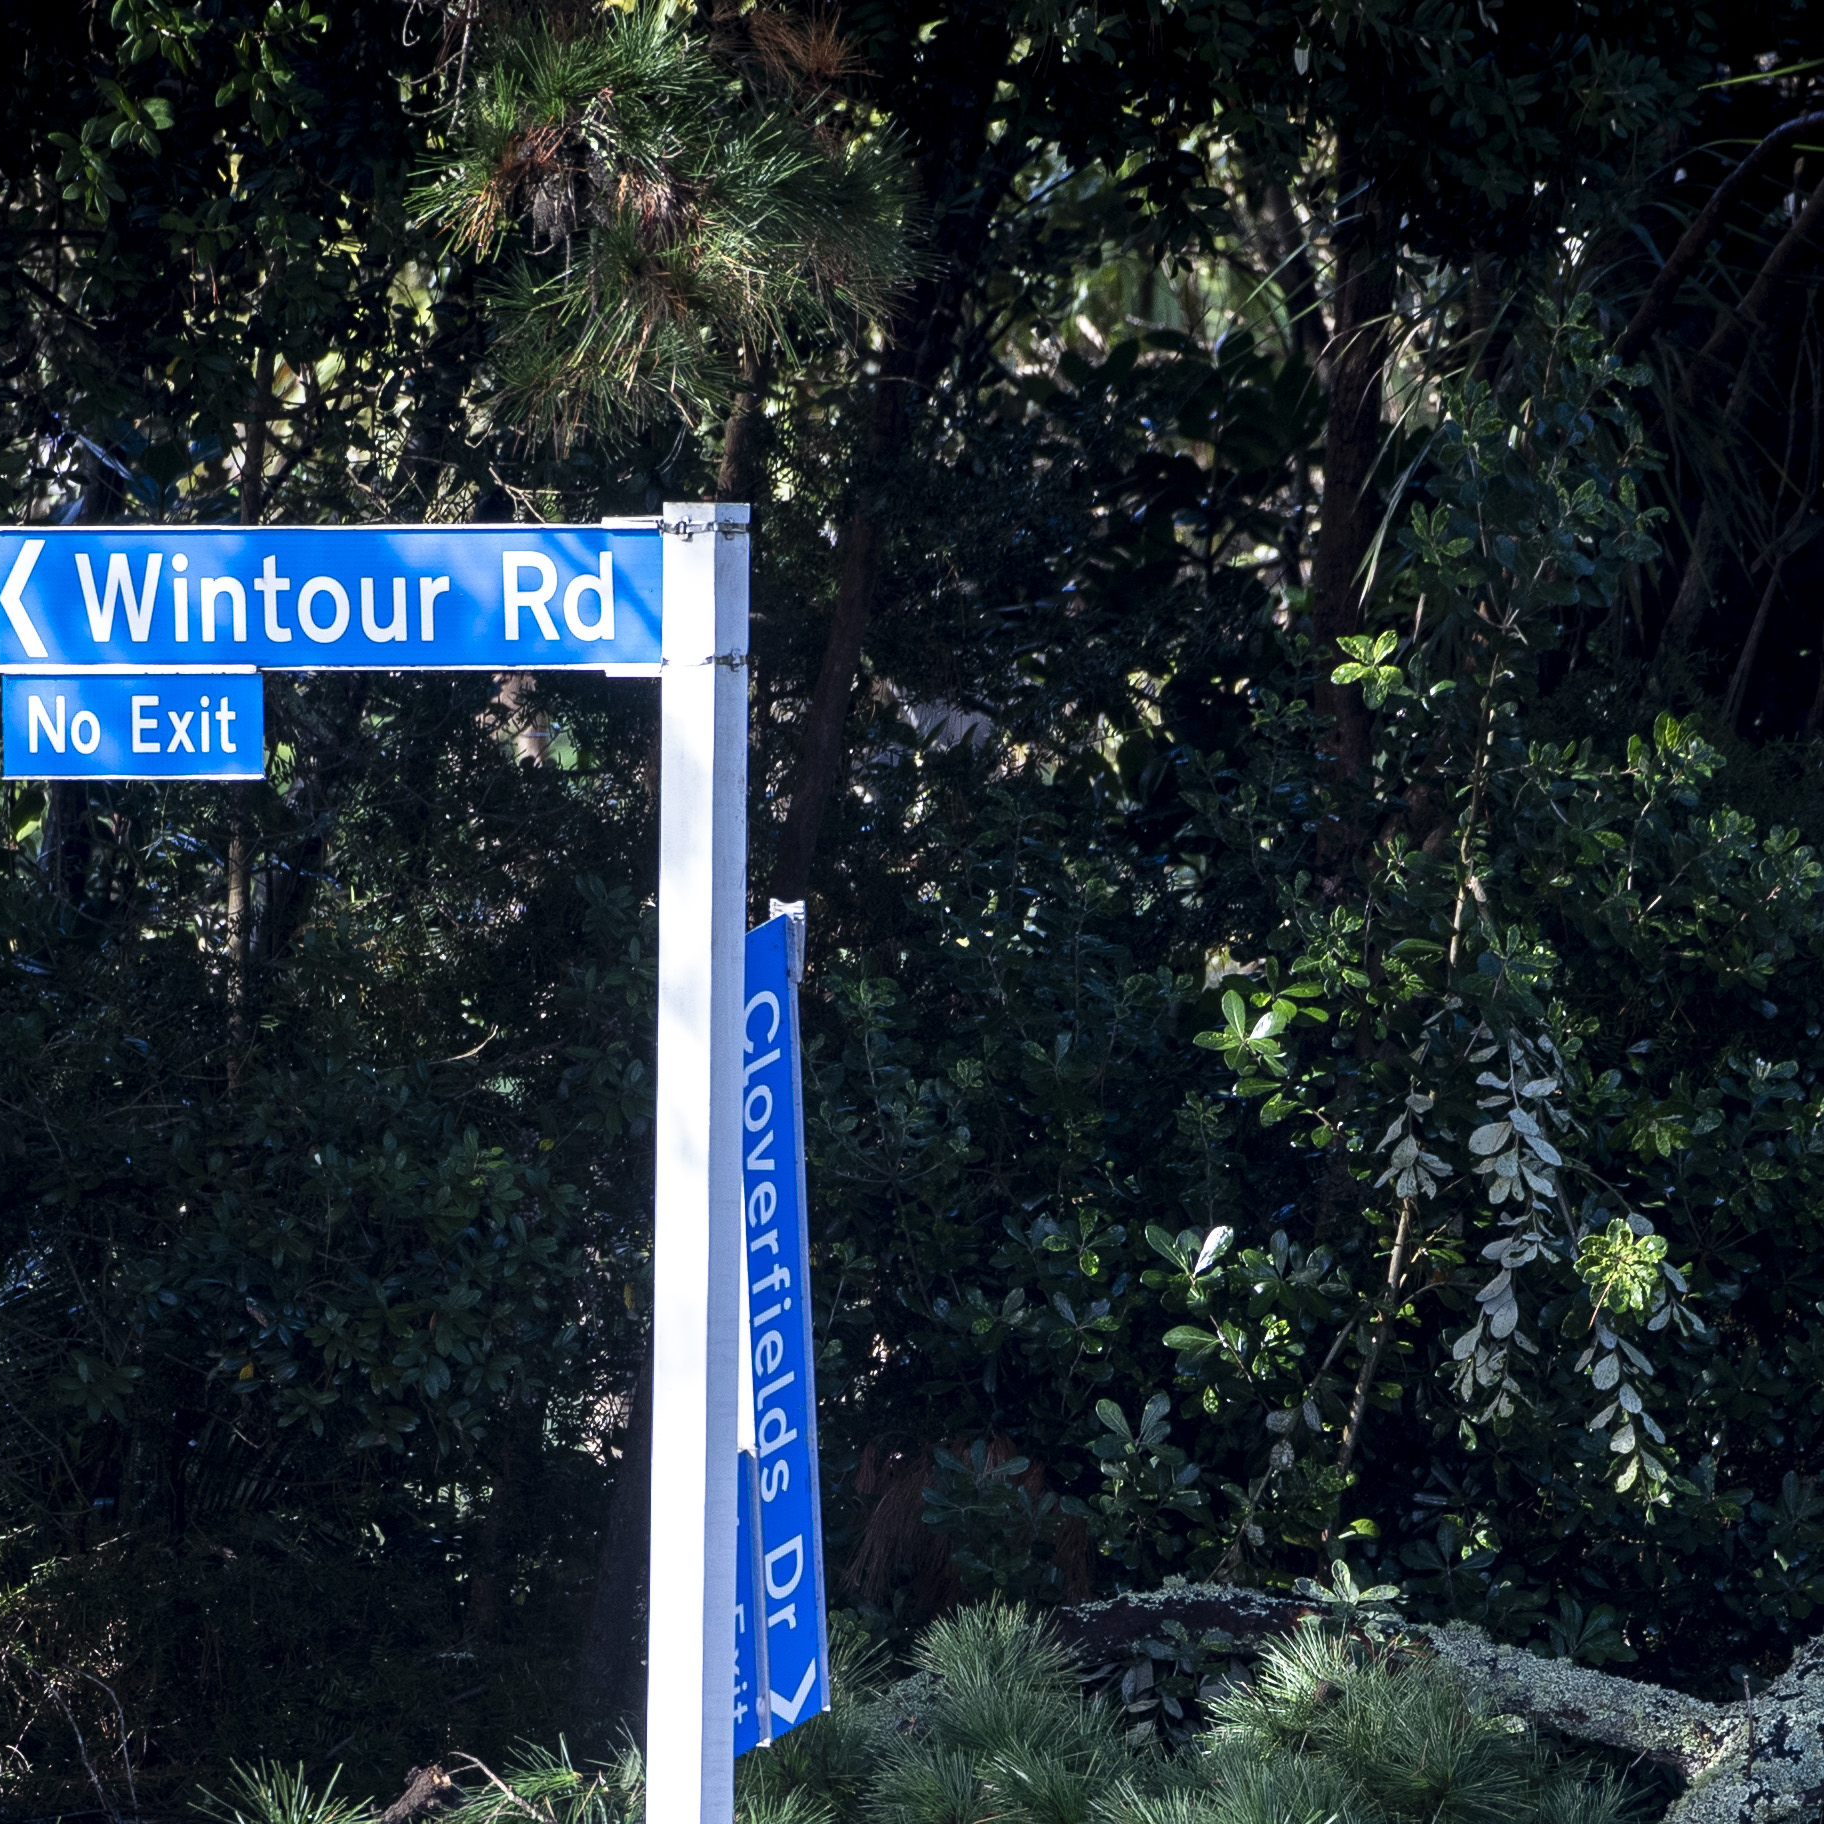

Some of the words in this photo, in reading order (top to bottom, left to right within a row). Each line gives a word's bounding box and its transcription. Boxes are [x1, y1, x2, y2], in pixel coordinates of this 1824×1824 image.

[75, 552, 449, 643] Wintour
[502, 550, 616, 642] Rd
[28, 696, 101, 754] No
[131, 695, 237, 754] Exit
[743, 990, 798, 1503] Cloverfields
[764, 1534, 804, 1630] Dr
